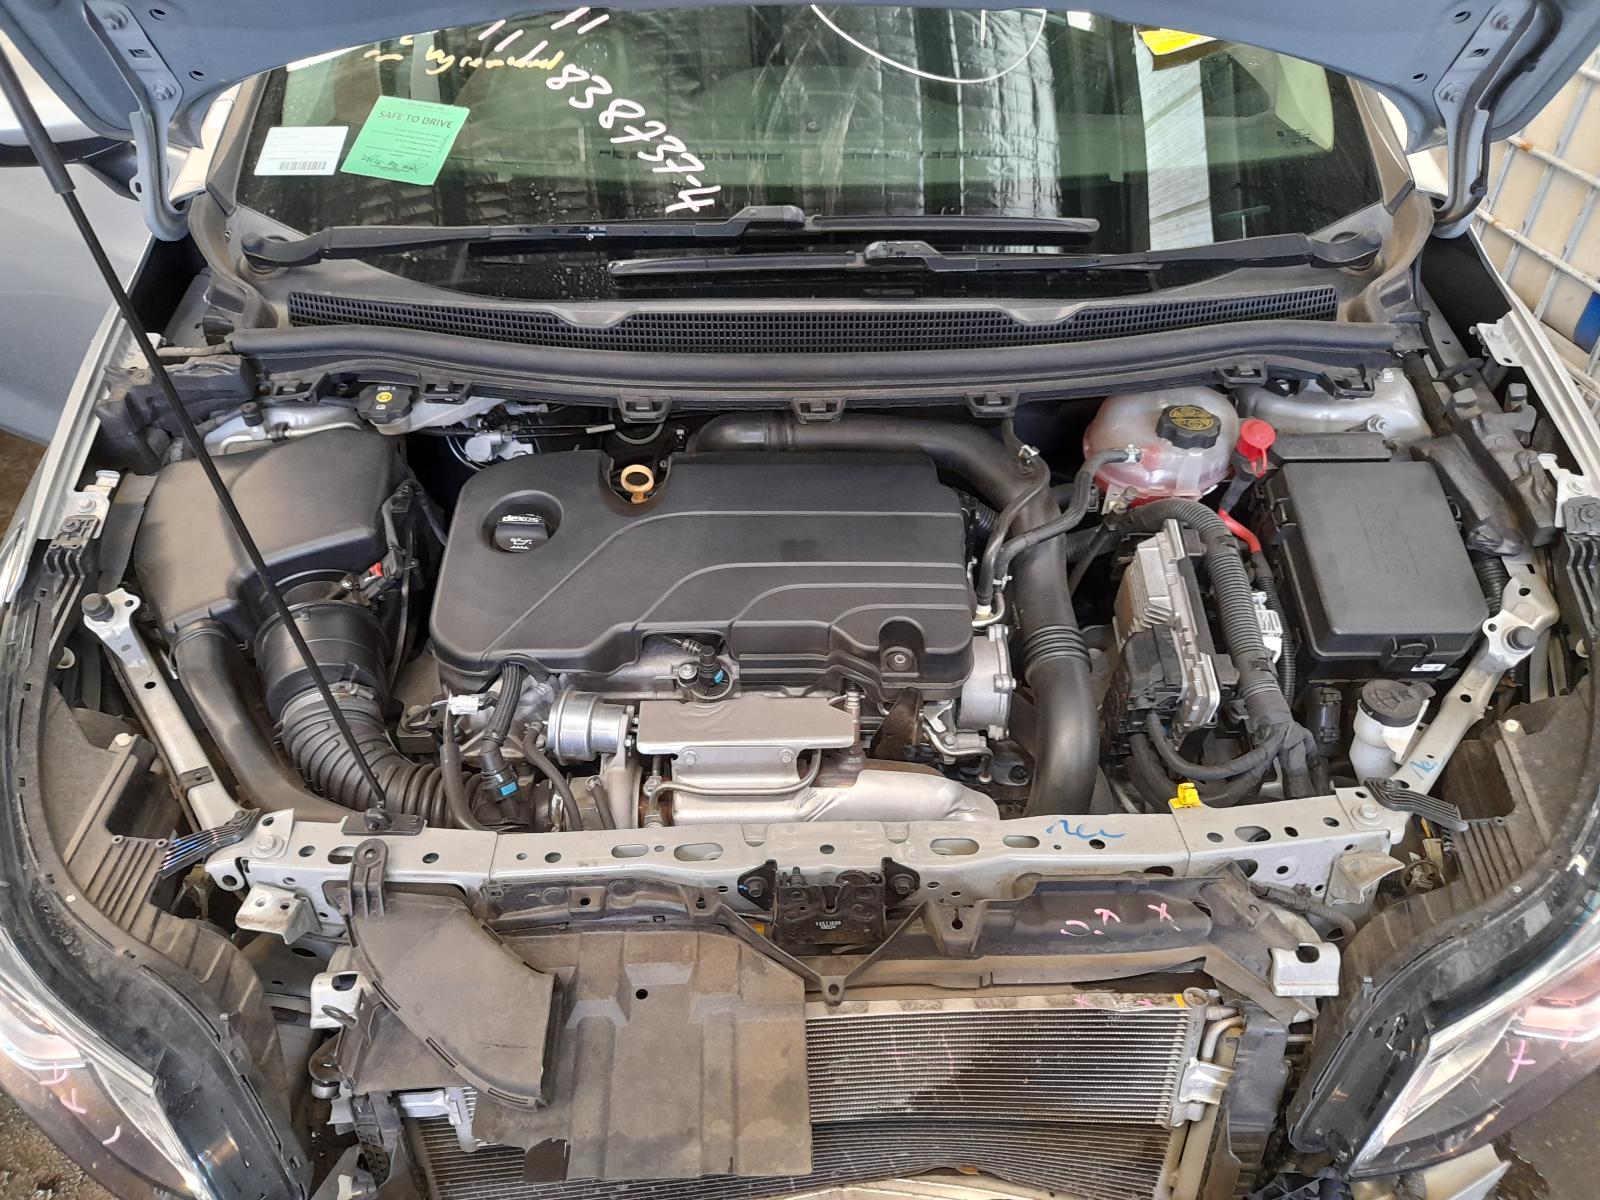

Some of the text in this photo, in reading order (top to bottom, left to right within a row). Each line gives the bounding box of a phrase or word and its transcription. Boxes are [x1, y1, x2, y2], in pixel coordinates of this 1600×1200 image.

[378, 110, 455, 129] SAFE TO DRIVE
